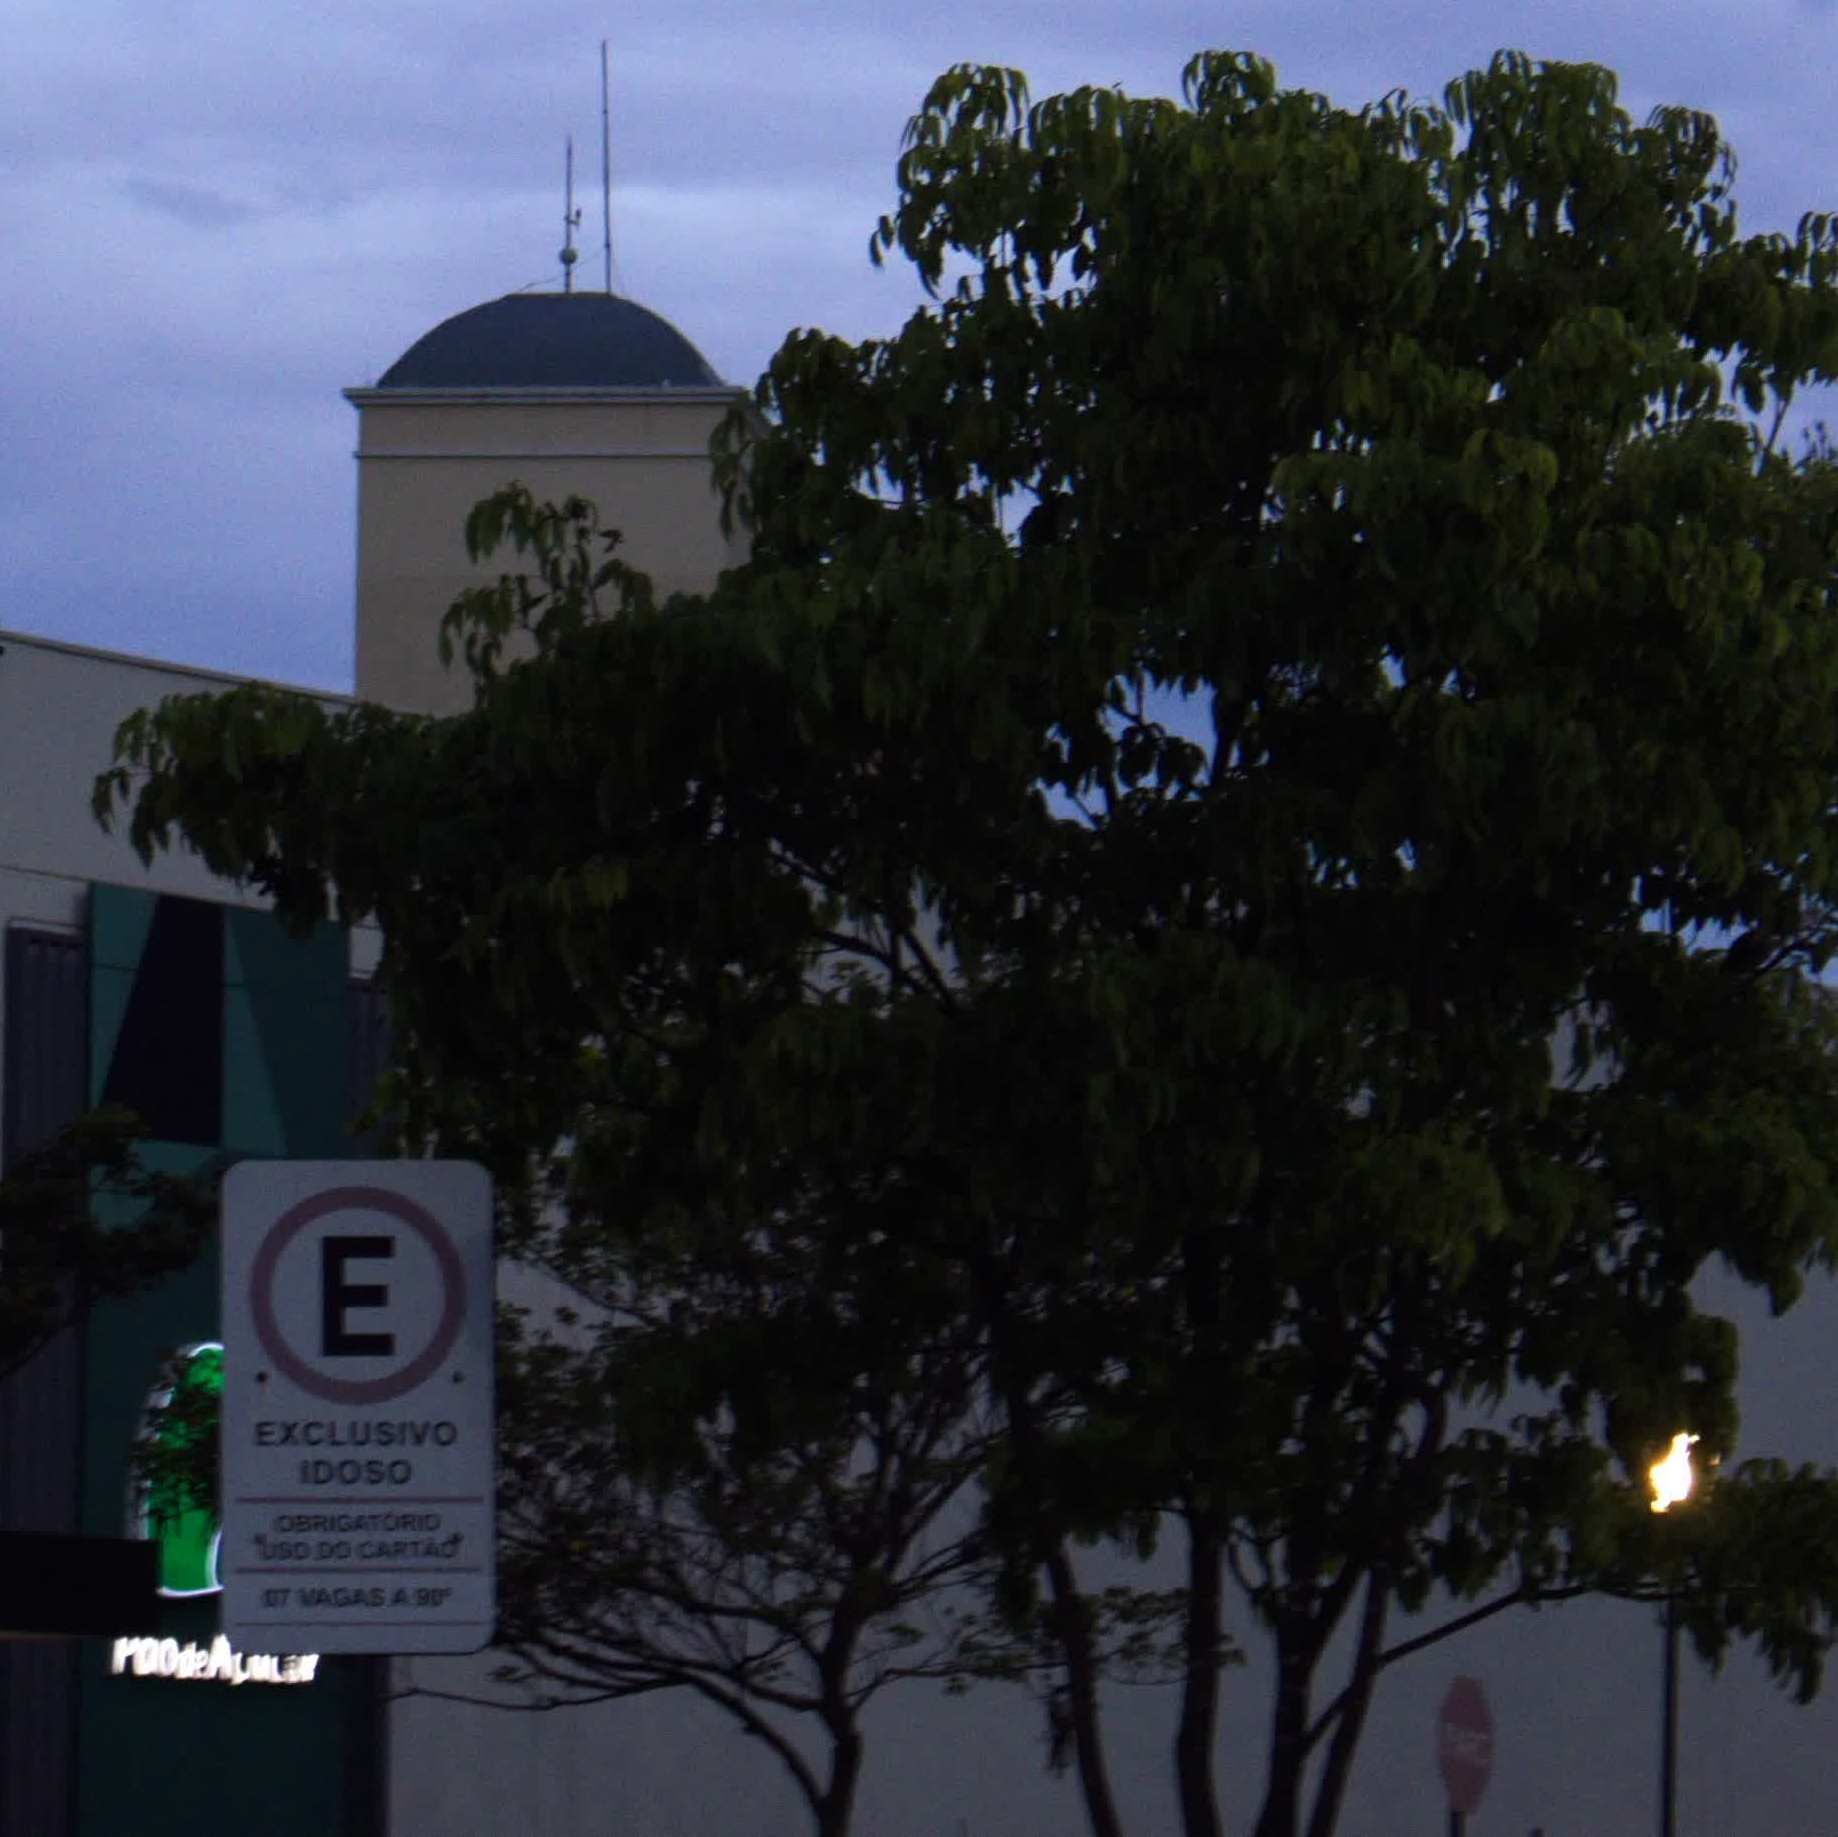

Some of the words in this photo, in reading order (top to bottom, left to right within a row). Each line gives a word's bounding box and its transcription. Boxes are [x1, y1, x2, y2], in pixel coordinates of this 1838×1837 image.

[320, 1235, 396, 1358] E
[254, 1420, 458, 1448] EXCLUSIVO
[298, 1459, 413, 1486] IDOSO
[316, 1540, 351, 1560] DO
[298, 1587, 387, 1608] VAGAS
